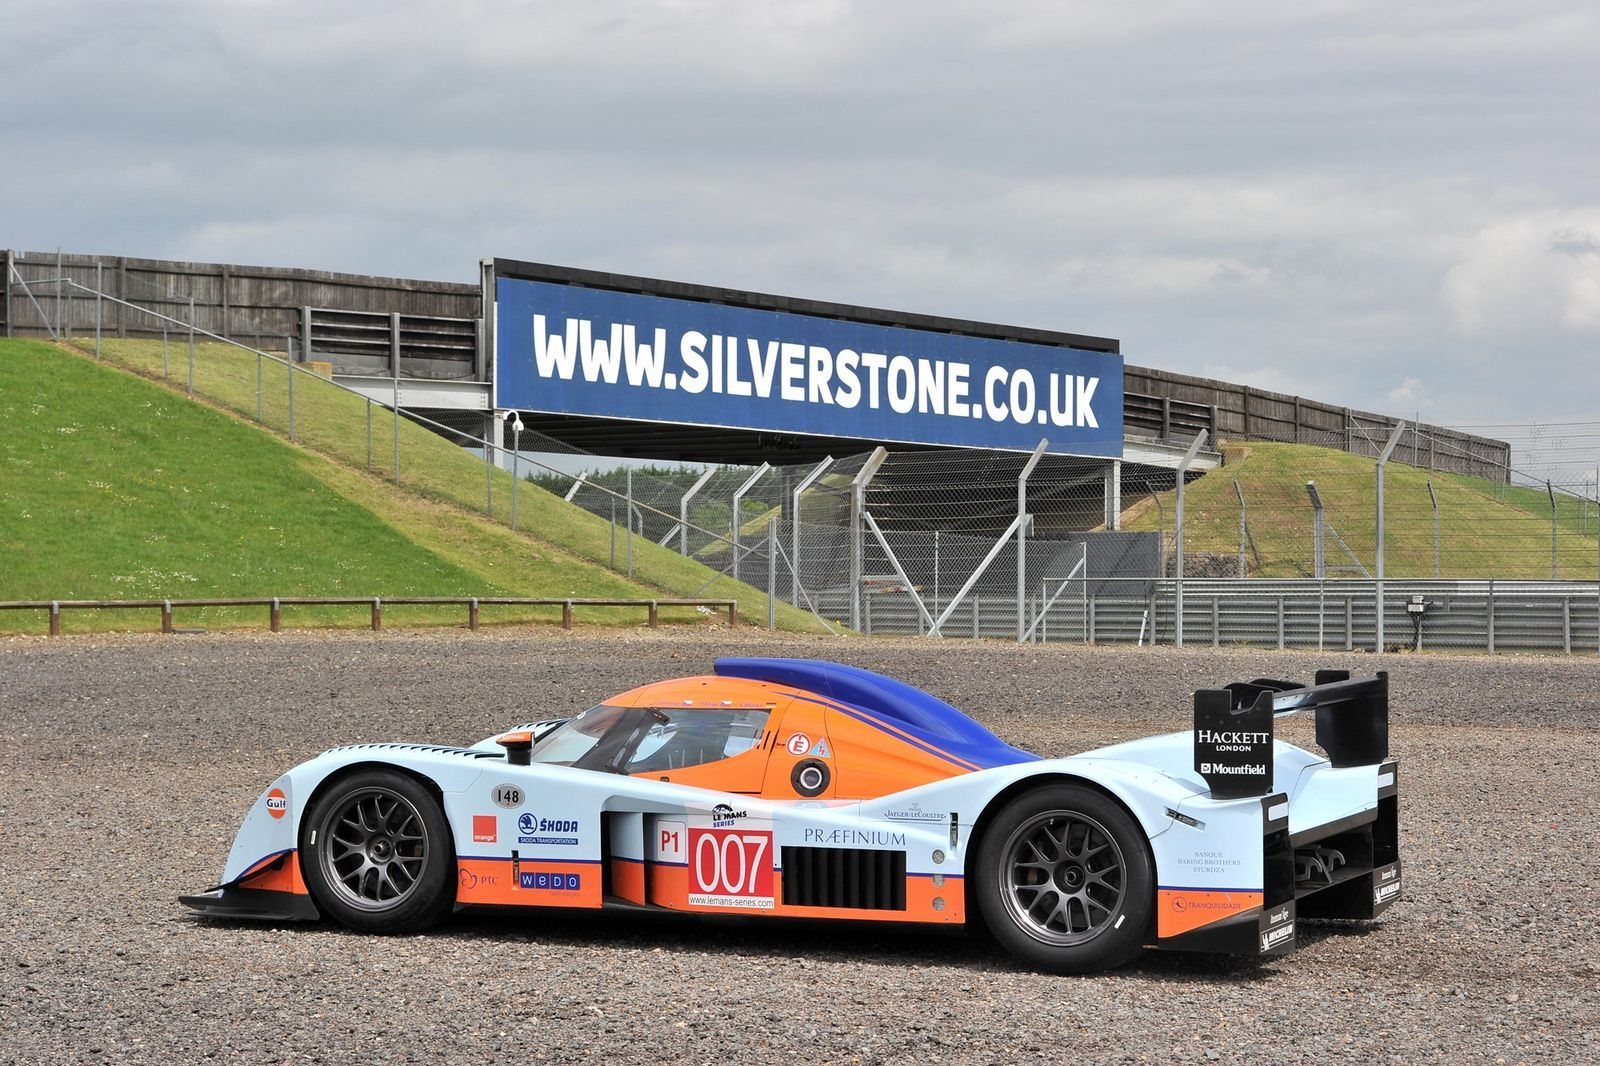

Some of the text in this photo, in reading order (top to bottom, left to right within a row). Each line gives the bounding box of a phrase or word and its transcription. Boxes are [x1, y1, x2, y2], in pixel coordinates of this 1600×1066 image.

[532, 314, 1100, 429] WWW.SILVERSTONE.CO.UK
[1198, 730, 1269, 744] HACKETT
[1212, 763, 1266, 775] Mountfield
[498, 790, 519, 802] 148
[266, 799, 287, 809] Gulf
[724, 811, 747, 820] MANS
[540, 818, 578, 832] ŠKODA
[713, 820, 735, 828] SERIES
[661, 830, 679, 853] P1
[805, 828, 906, 846] PRÆFINIUM
[695, 833, 768, 894] 007
[689, 896, 773, 908] www.lemans-series.com
